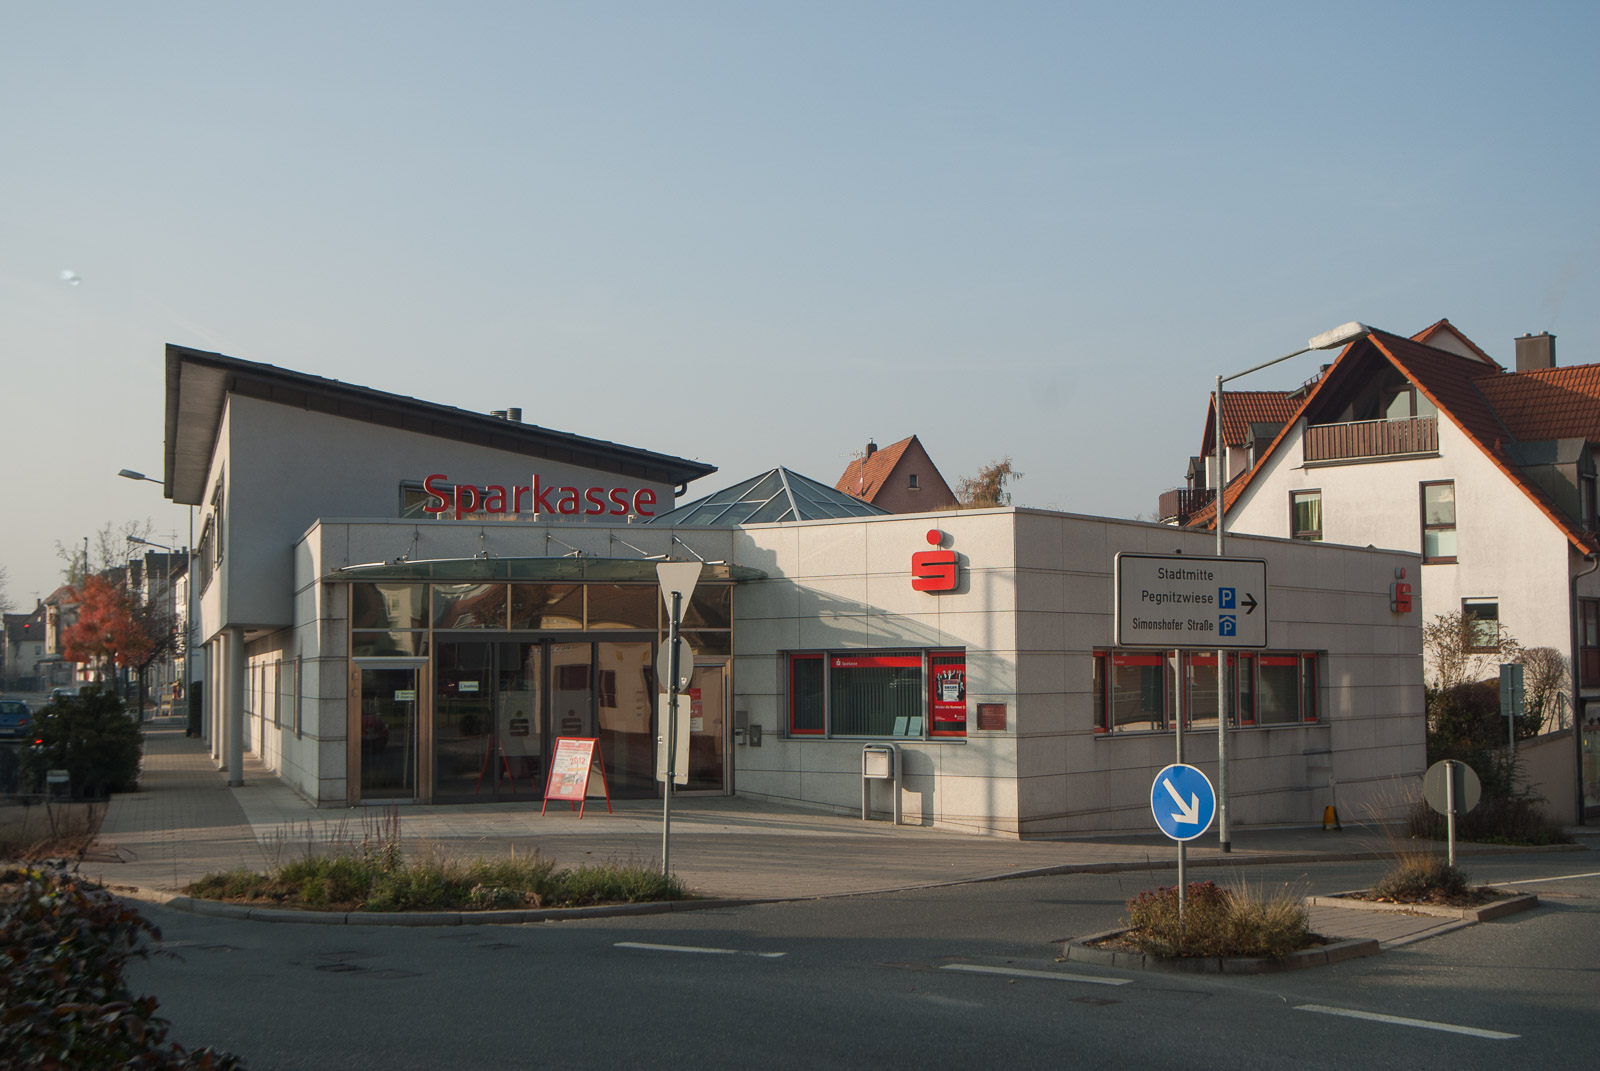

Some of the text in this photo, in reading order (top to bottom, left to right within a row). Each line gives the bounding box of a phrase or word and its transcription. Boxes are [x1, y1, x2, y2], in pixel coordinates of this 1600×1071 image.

[423, 473, 657, 520] Sparkasse
[1157, 567, 1214, 581] Stadtmitte
[1141, 590, 1214, 605] Pegnitzwiese
[1132, 618, 1183, 631] Simonshofer
[1187, 619, 1214, 631] Straße
[569, 756, 586, 766] 2012
